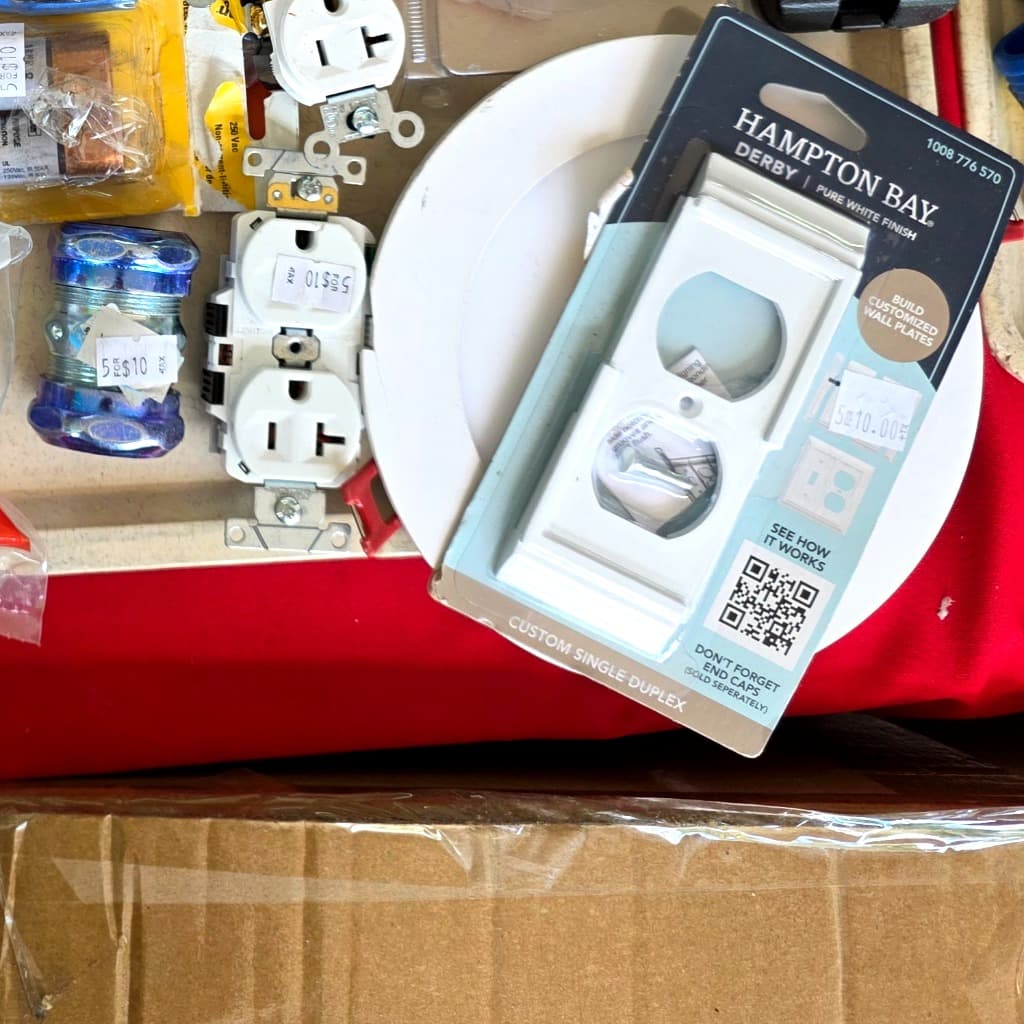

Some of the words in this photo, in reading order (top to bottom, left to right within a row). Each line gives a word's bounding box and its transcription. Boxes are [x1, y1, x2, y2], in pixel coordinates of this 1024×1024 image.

[0, 45, 19, 71] $10
[0, 72, 18, 81] FOR
[0, 82, 18, 92] 5
[230, 121, 238, 137] 250
[733, 107, 883, 197] HAMPTON
[881, 182, 940, 226] BAY
[926, 137, 954, 160] 1008
[956, 153, 978, 173] 776
[978, 166, 1002, 185] 570
[733, 141, 799, 181] DERBY
[816, 184, 846, 205] PURE
[845, 198, 881, 223] WHITE
[881, 217, 918, 241] FINISH
[305, 270, 330, 289] $10
[331, 273, 339, 292] FOR
[340, 276, 352, 295] 5
[867, 296, 939, 337] CUSTOMIZED
[892, 294, 925, 317] BUILD
[864, 306, 894, 328] WALL
[894, 320, 935, 348] PLATES
[102, 358, 110, 378] 5
[112, 358, 120, 377] FOR
[122, 356, 148, 377] $10
[834, 404, 846, 425] 5
[763, 534, 777, 547] IT
[778, 541, 827, 572] WORKS
[770, 522, 797, 542] SEE
[796, 536, 831, 559] HOW
[508, 615, 572, 655] CUSTOM
[573, 648, 627, 683] SINGLE
[628, 675, 689, 714] DUPLEX
[694, 643, 734, 669] DON'T
[733, 664, 781, 694] FORGET
[702, 661, 729, 680] END
[730, 676, 761, 697] CAPS
[711, 680, 769, 714] SEPERATELY)
